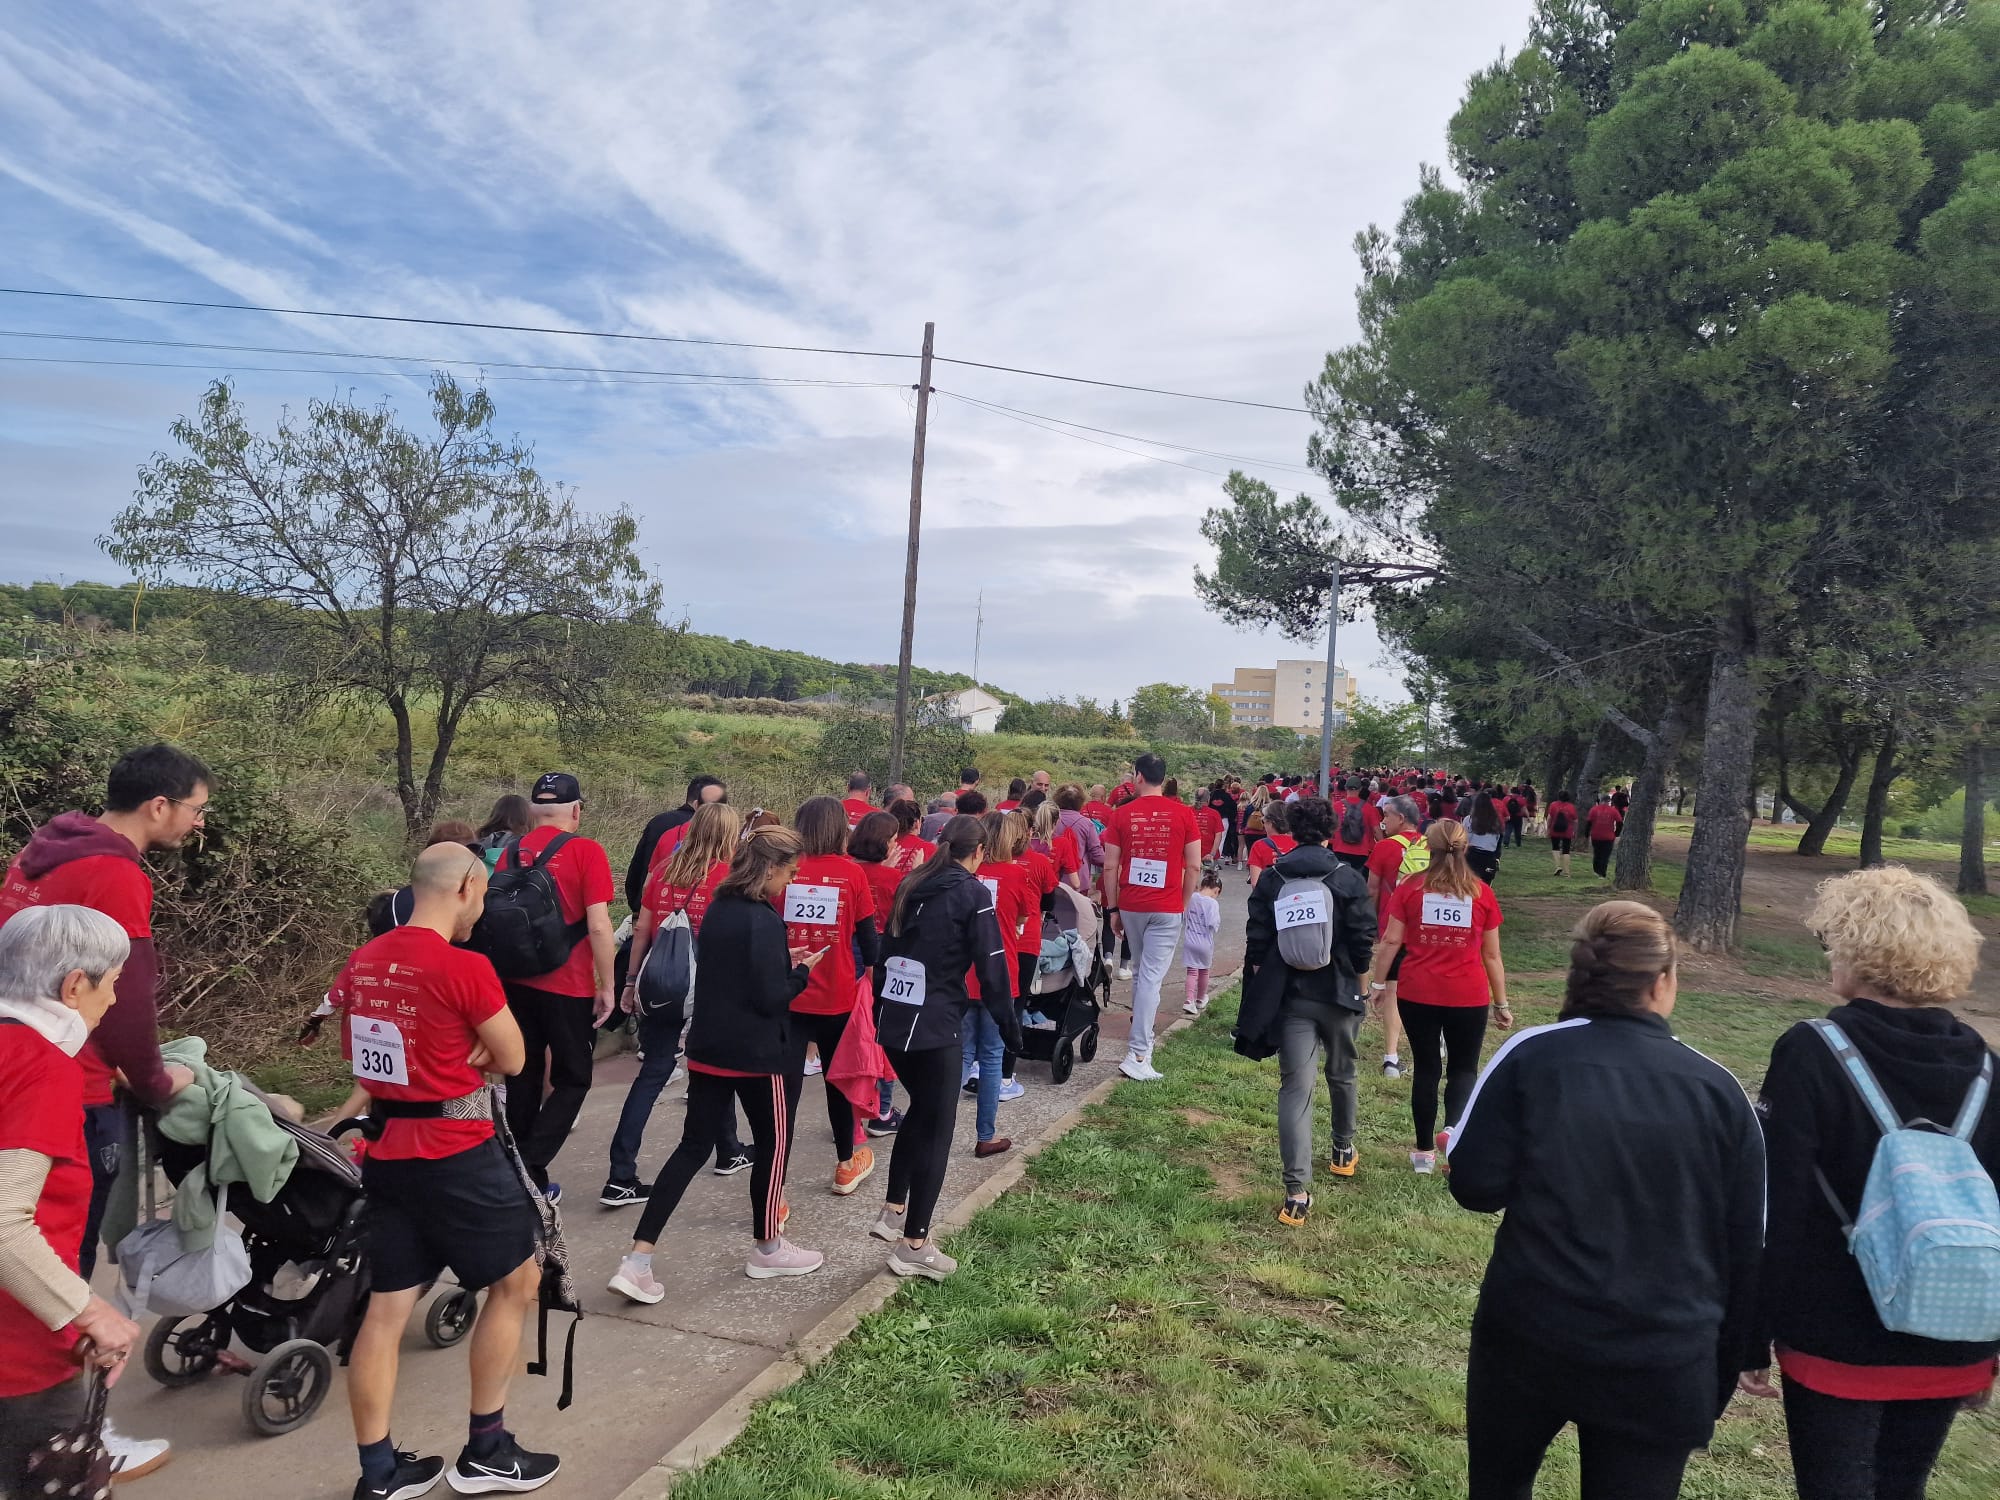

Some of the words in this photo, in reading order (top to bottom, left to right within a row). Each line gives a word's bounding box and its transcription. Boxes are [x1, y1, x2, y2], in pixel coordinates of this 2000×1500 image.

[1137, 871, 1158, 884] 125
[795, 903, 826, 919] 232
[1286, 907, 1315, 923] 228
[1434, 907, 1461, 922] 156
[889, 977, 915, 997] 207
[361, 1048, 393, 1075] 330
